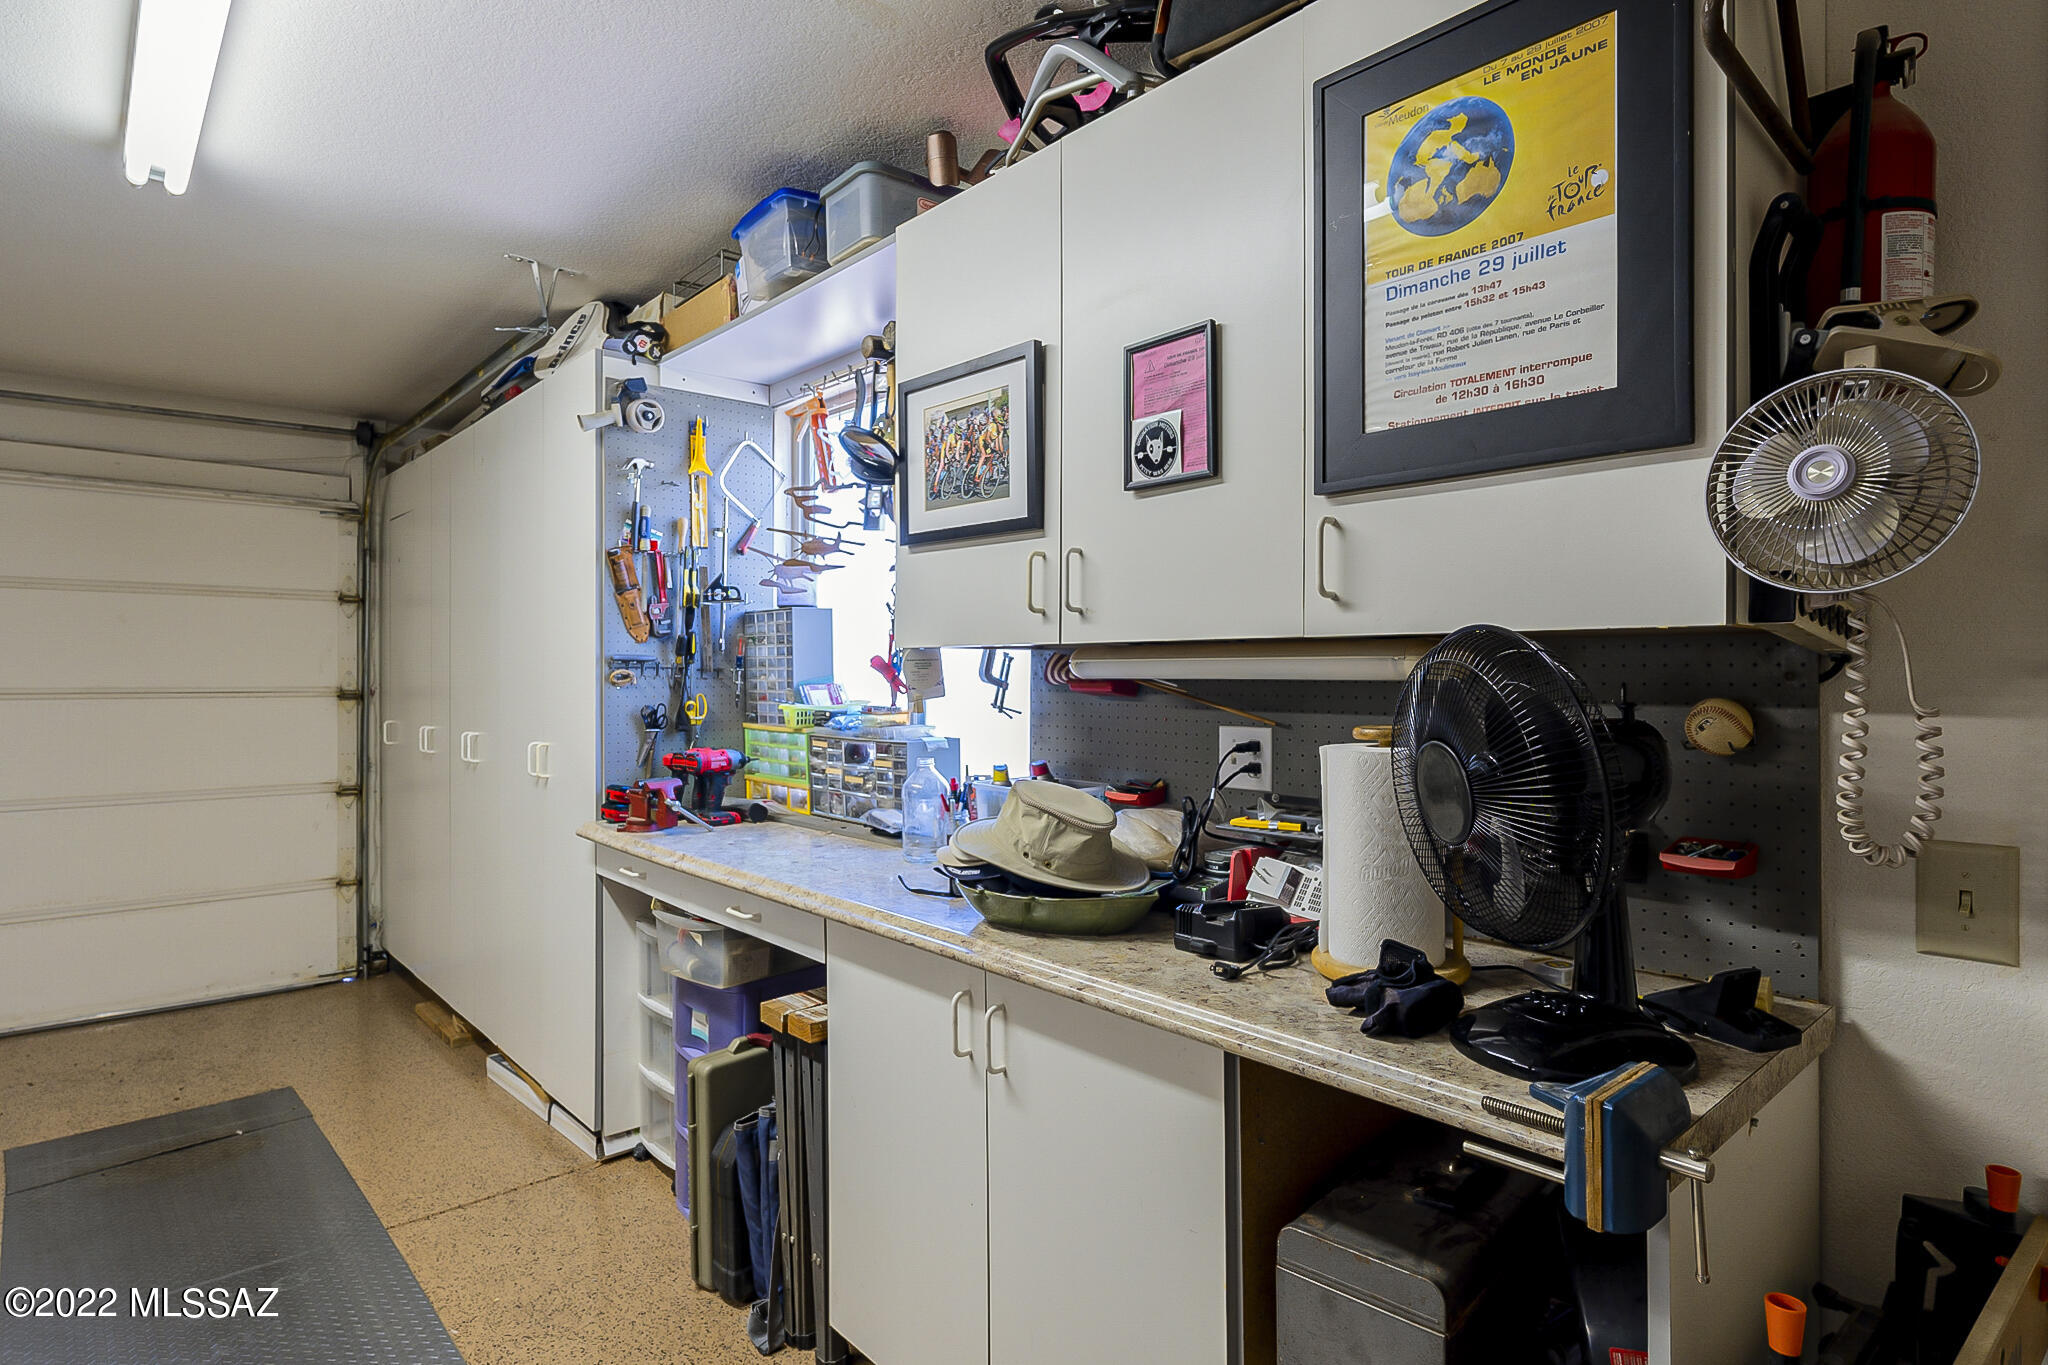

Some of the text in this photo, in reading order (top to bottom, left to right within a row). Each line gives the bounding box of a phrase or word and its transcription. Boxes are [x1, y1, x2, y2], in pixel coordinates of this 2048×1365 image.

[1502, 58, 1508, 66] 7
[1511, 54, 1524, 62] au
[1545, 33, 1573, 50] juillet
[1575, 16, 1608, 35] 2007
[1484, 44, 1567, 86] LE MONDE
[1521, 39, 1608, 81] EN JAUNE
[1389, 104, 1429, 126] Meudon
[1385, 232, 1523, 280] TOUR DE FRANCE 2007
[1386, 240, 1567, 301] Dimanche 29 juillet
[1445, 305, 1462, 314] entre
[1464, 293, 1495, 308] 15h32
[1498, 291, 1509, 300] et
[1512, 280, 1546, 296] 15h43
[1471, 279, 1502, 295] 13h47
[1436, 331, 1448, 339] RD
[1446, 343, 1470, 354] Robert
[1472, 337, 1493, 348] Julien
[1522, 328, 1535, 336] rue
[1549, 320, 1571, 331] Paris
[1572, 317, 1581, 325] et
[1460, 334, 1469, 342] de
[1471, 331, 1478, 339] la
[1524, 316, 1552, 327] avenue
[1554, 313, 1564, 321] Le
[1394, 353, 1592, 399] Circulation TOTALEMENT interrompue
[1436, 374, 1545, 404] de 12h30 à 16h30
